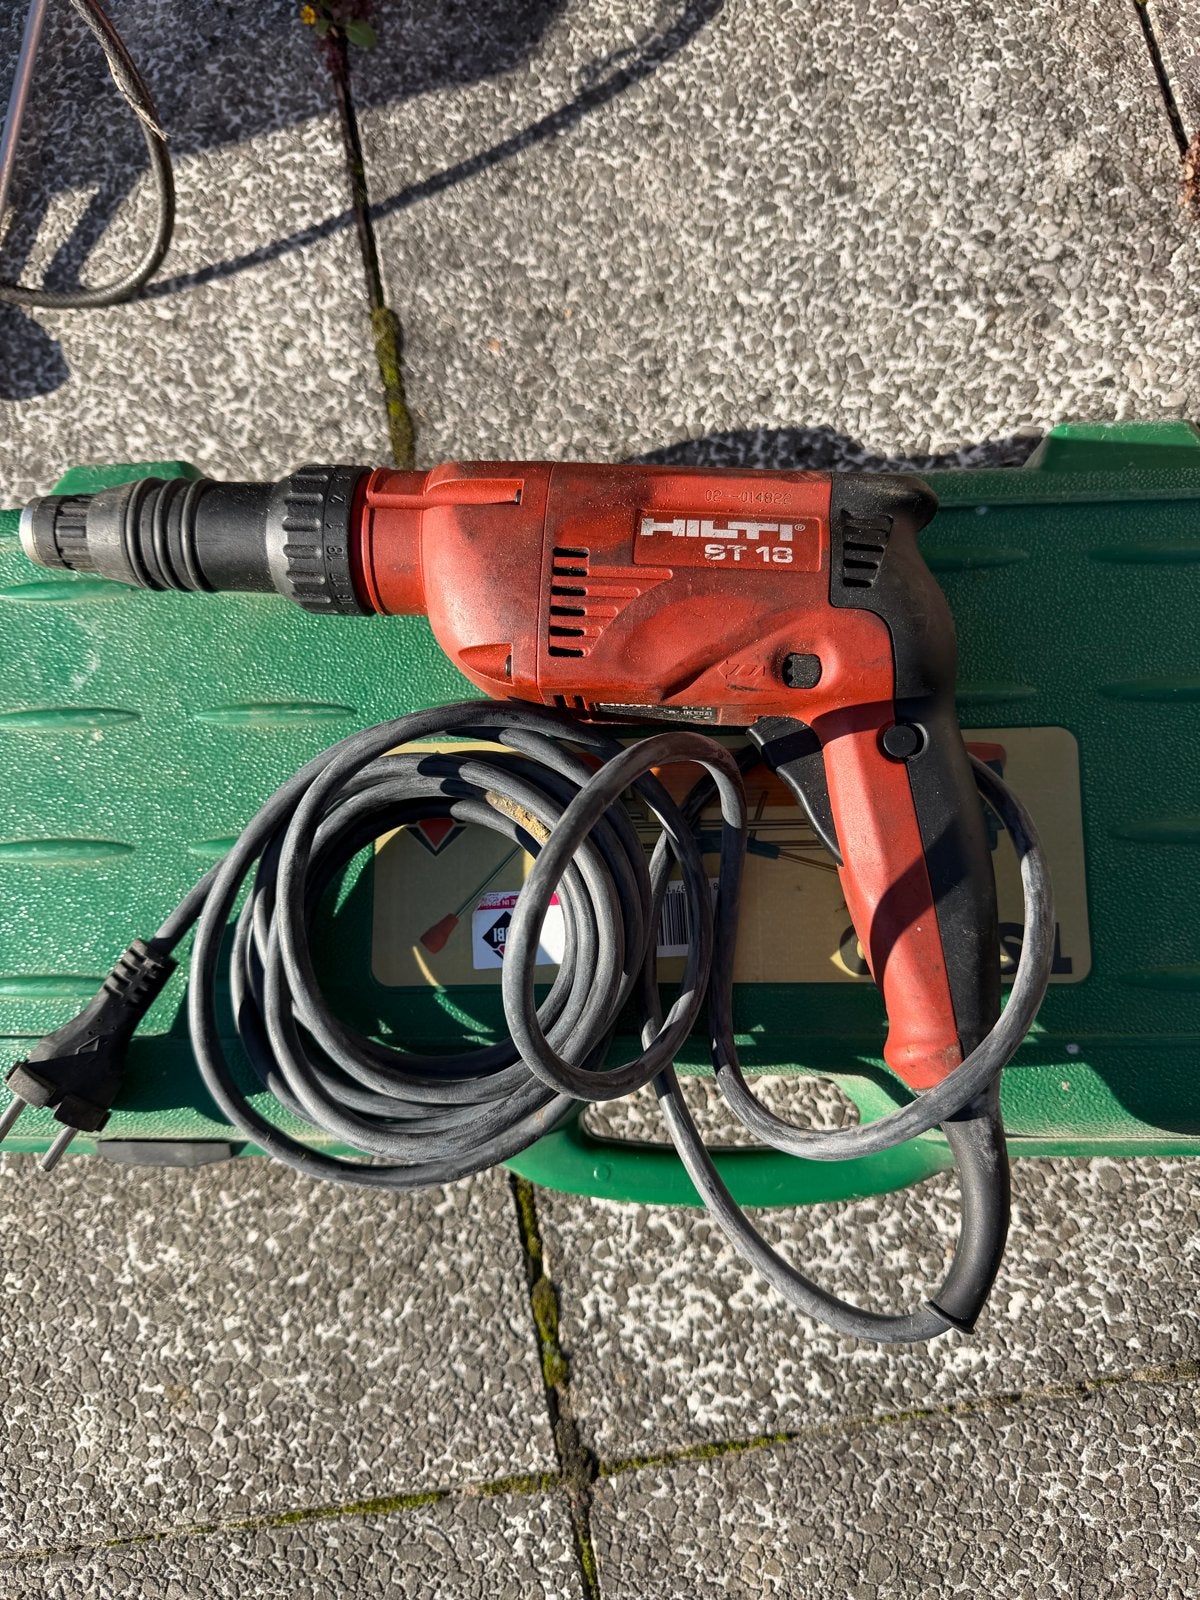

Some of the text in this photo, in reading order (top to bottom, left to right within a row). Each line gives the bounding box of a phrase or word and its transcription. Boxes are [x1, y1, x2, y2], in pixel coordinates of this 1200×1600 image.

[640, 518, 793, 541] HILTI
[326, 545, 345, 562] 18
[704, 544, 793, 563] ST 18
